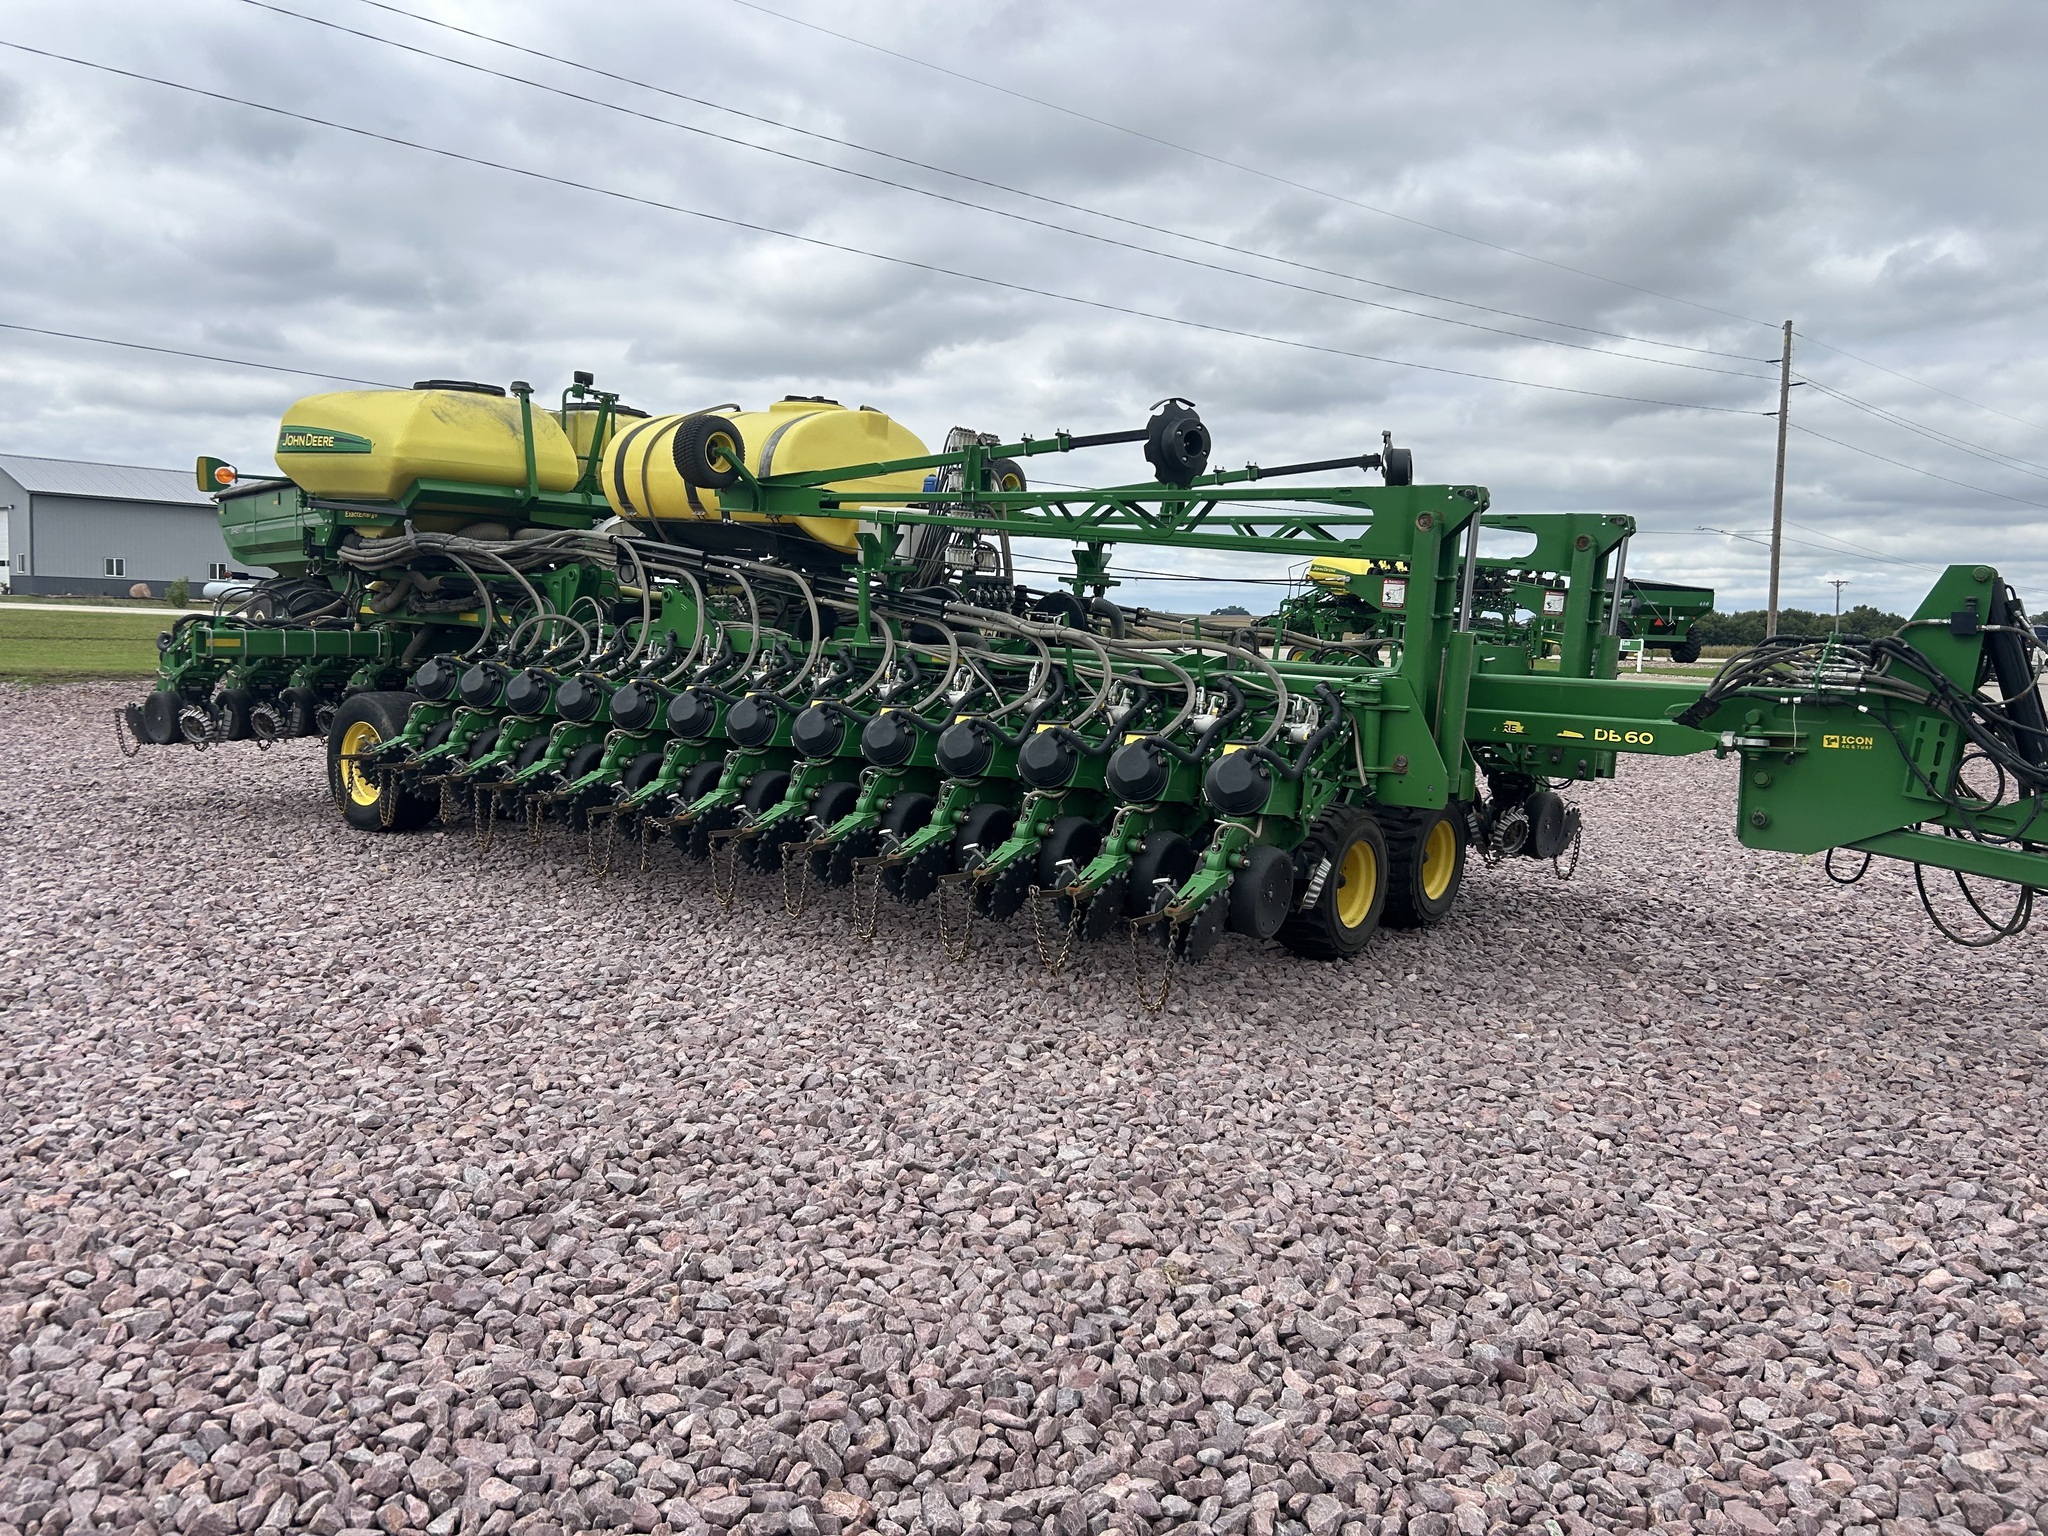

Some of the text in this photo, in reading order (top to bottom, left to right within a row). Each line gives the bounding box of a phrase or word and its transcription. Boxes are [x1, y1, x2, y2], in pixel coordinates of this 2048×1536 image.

[282, 433, 335, 447] JOHN DEERE
[1624, 731, 1654, 745] 60
[1841, 735, 1873, 745] ICON
